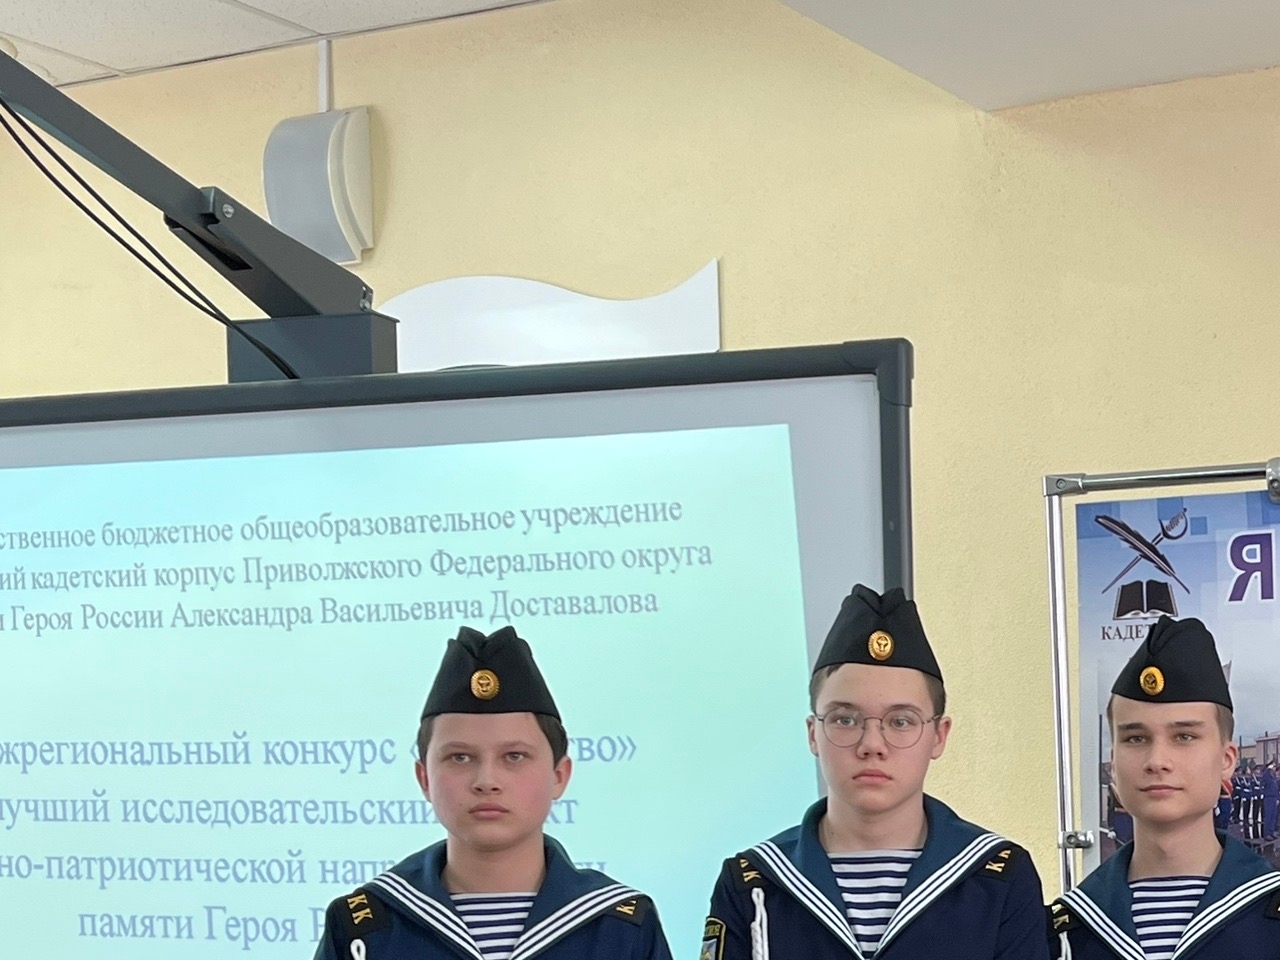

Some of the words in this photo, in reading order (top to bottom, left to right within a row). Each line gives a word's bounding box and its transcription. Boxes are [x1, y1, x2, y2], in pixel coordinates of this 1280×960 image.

[102, 522, 233, 549] бюджетное
[240, 508, 516, 544] общеобразовательное
[520, 500, 683, 535] учреждение
[31, 563, 147, 592] кадетский
[154, 564, 236, 592] корпус
[243, 557, 422, 590] Приволжского
[430, 549, 615, 580] Федерального
[621, 544, 713, 574] округа
[1227, 532, 1275, 603] Я
[11, 604, 73, 637] Героя
[81, 603, 164, 630] России
[170, 602, 313, 631] Александра
[319, 597, 484, 624] Васильевича
[490, 590, 659, 624] Доставалова
[263, 736, 396, 774] конкурс
[78, 912, 195, 939] памяти
[203, 905, 299, 950] Героя
